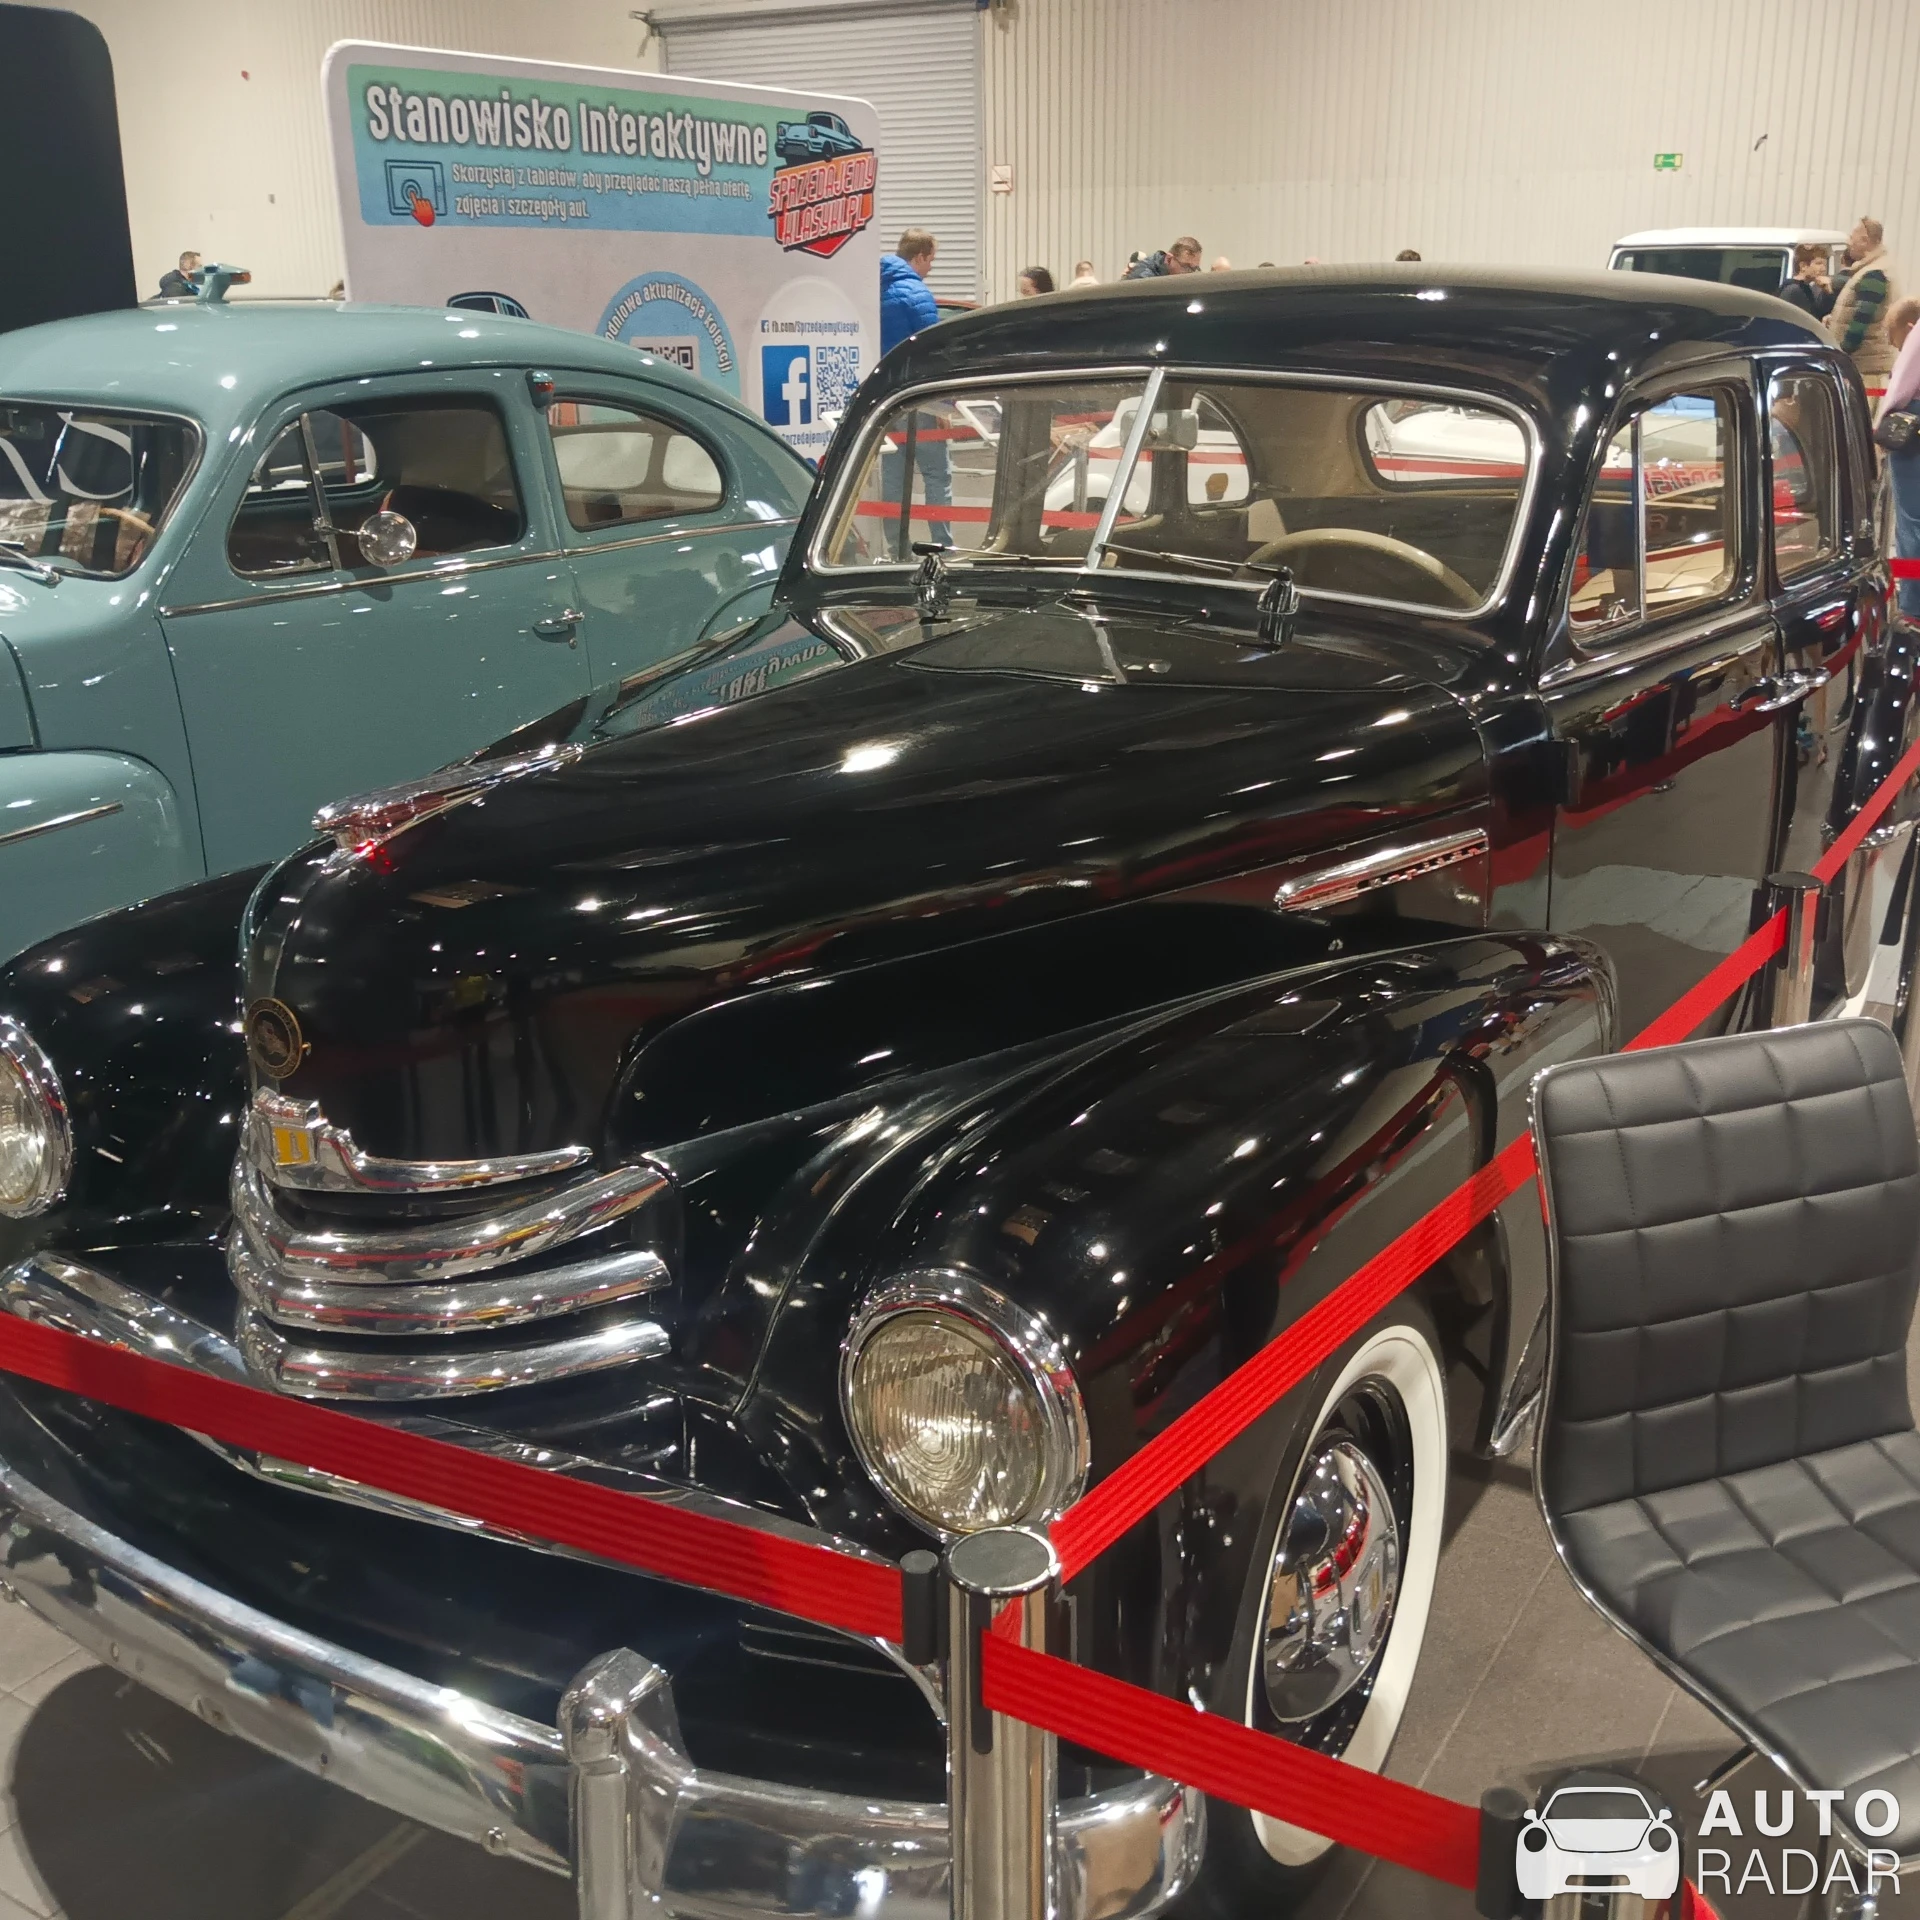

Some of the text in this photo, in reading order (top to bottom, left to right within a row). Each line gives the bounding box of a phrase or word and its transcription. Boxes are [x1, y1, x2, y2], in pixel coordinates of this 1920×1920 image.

[366, 84, 768, 175] Stanowisko Interaktywne
[452, 163, 516, 189] Skorzystaj
[518, 168, 525, 185] z
[526, 164, 580, 191] tabletów,
[582, 171, 602, 194] aby
[604, 171, 661, 196] przeglądać
[662, 177, 692, 197] naszą
[693, 179, 721, 200] pełną
[767, 157, 879, 215] SPRZEDAJEMY
[455, 193, 591, 222] zdjęcia i szczegóły aut.
[782, 193, 866, 247] KLASYKI.PL
[642, 282, 706, 319] aktualizacja
